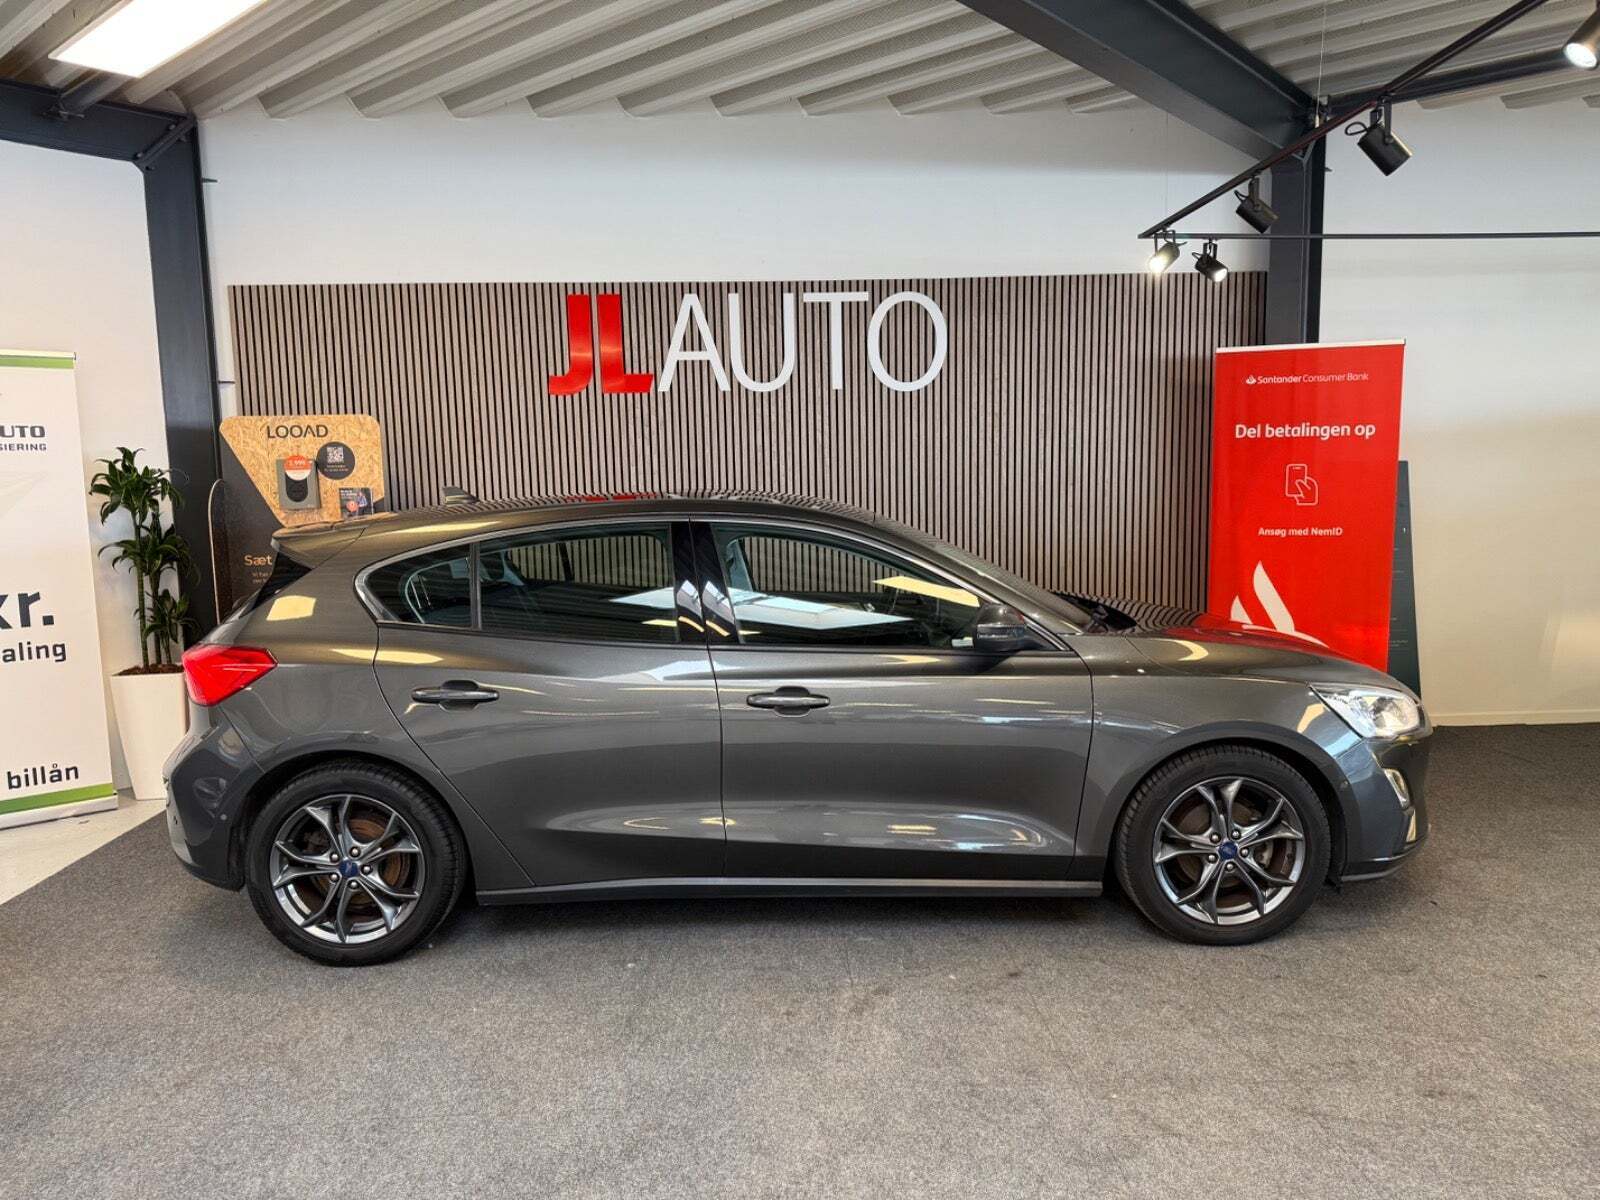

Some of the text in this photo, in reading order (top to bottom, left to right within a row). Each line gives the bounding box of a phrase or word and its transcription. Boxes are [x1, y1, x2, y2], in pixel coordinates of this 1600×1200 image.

[548, 291, 948, 395] JL AUTO
[1257, 372, 1369, 385] Santander Consumer Bank
[266, 424, 329, 439] LOOAD
[1235, 423, 1376, 441] Del betalingen op
[1258, 527, 1343, 538] Ansøg med NemID
[7, 763, 79, 790] billån
